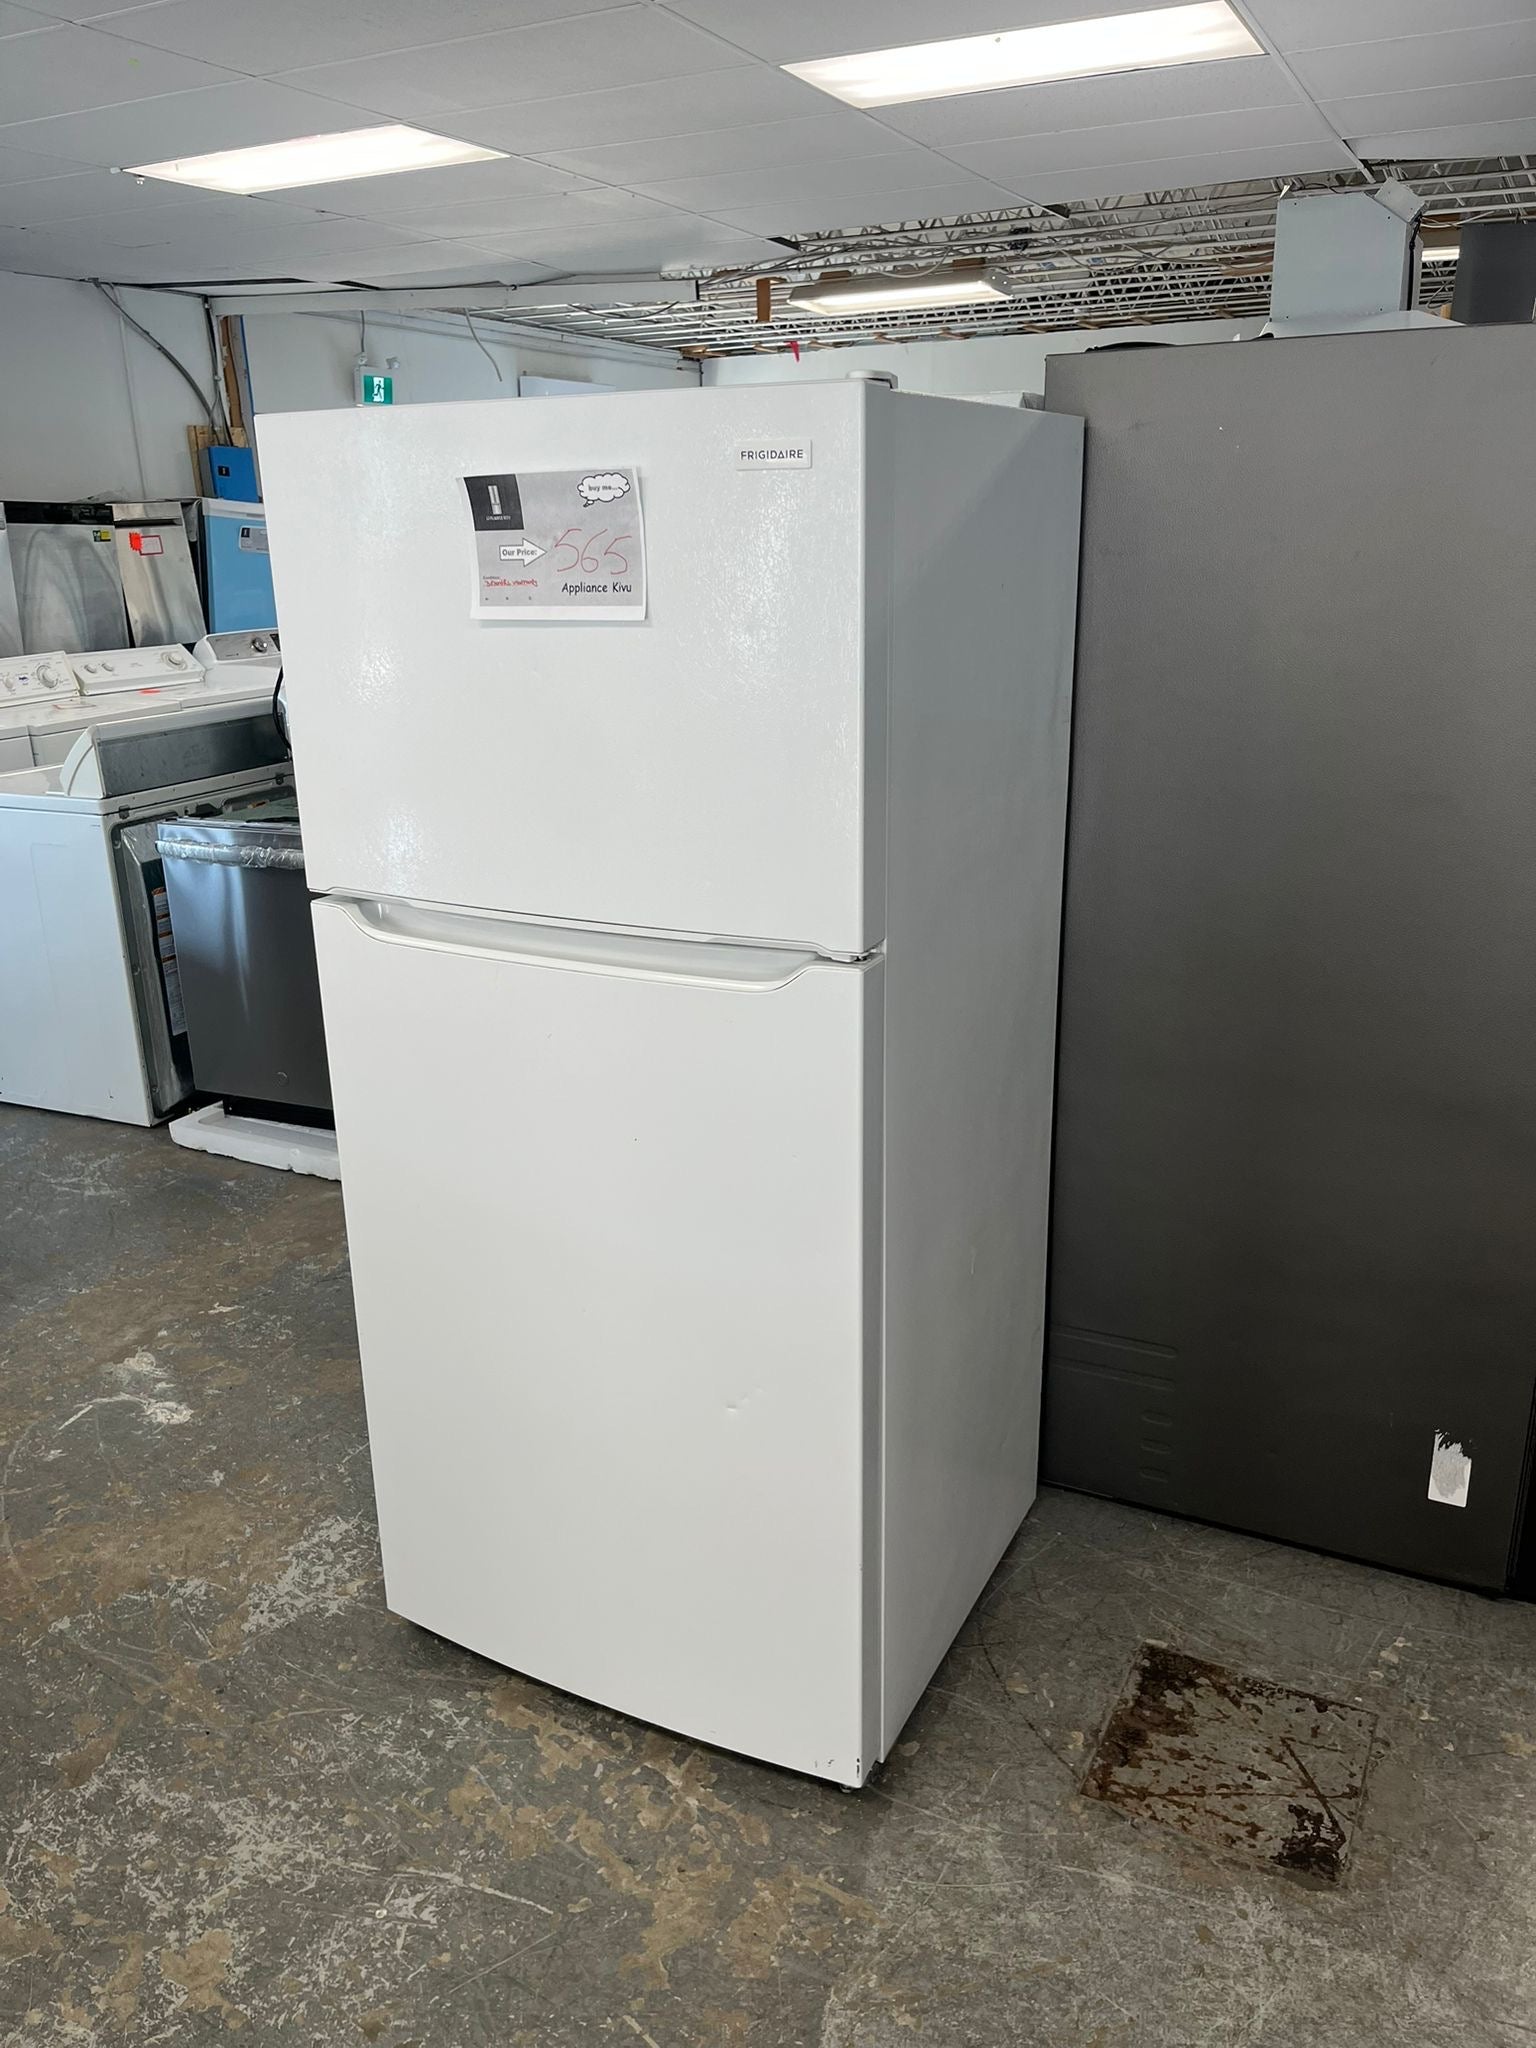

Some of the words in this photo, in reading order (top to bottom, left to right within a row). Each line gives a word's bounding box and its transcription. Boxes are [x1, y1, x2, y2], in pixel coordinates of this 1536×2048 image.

[740, 449, 804, 460] FRIGIDAIRE
[588, 484, 600, 492] buy
[516, 548, 538, 556] Price:
[555, 528, 632, 575] 565
[561, 583, 608, 596] Appliance
[612, 581, 632, 593] Kivu
